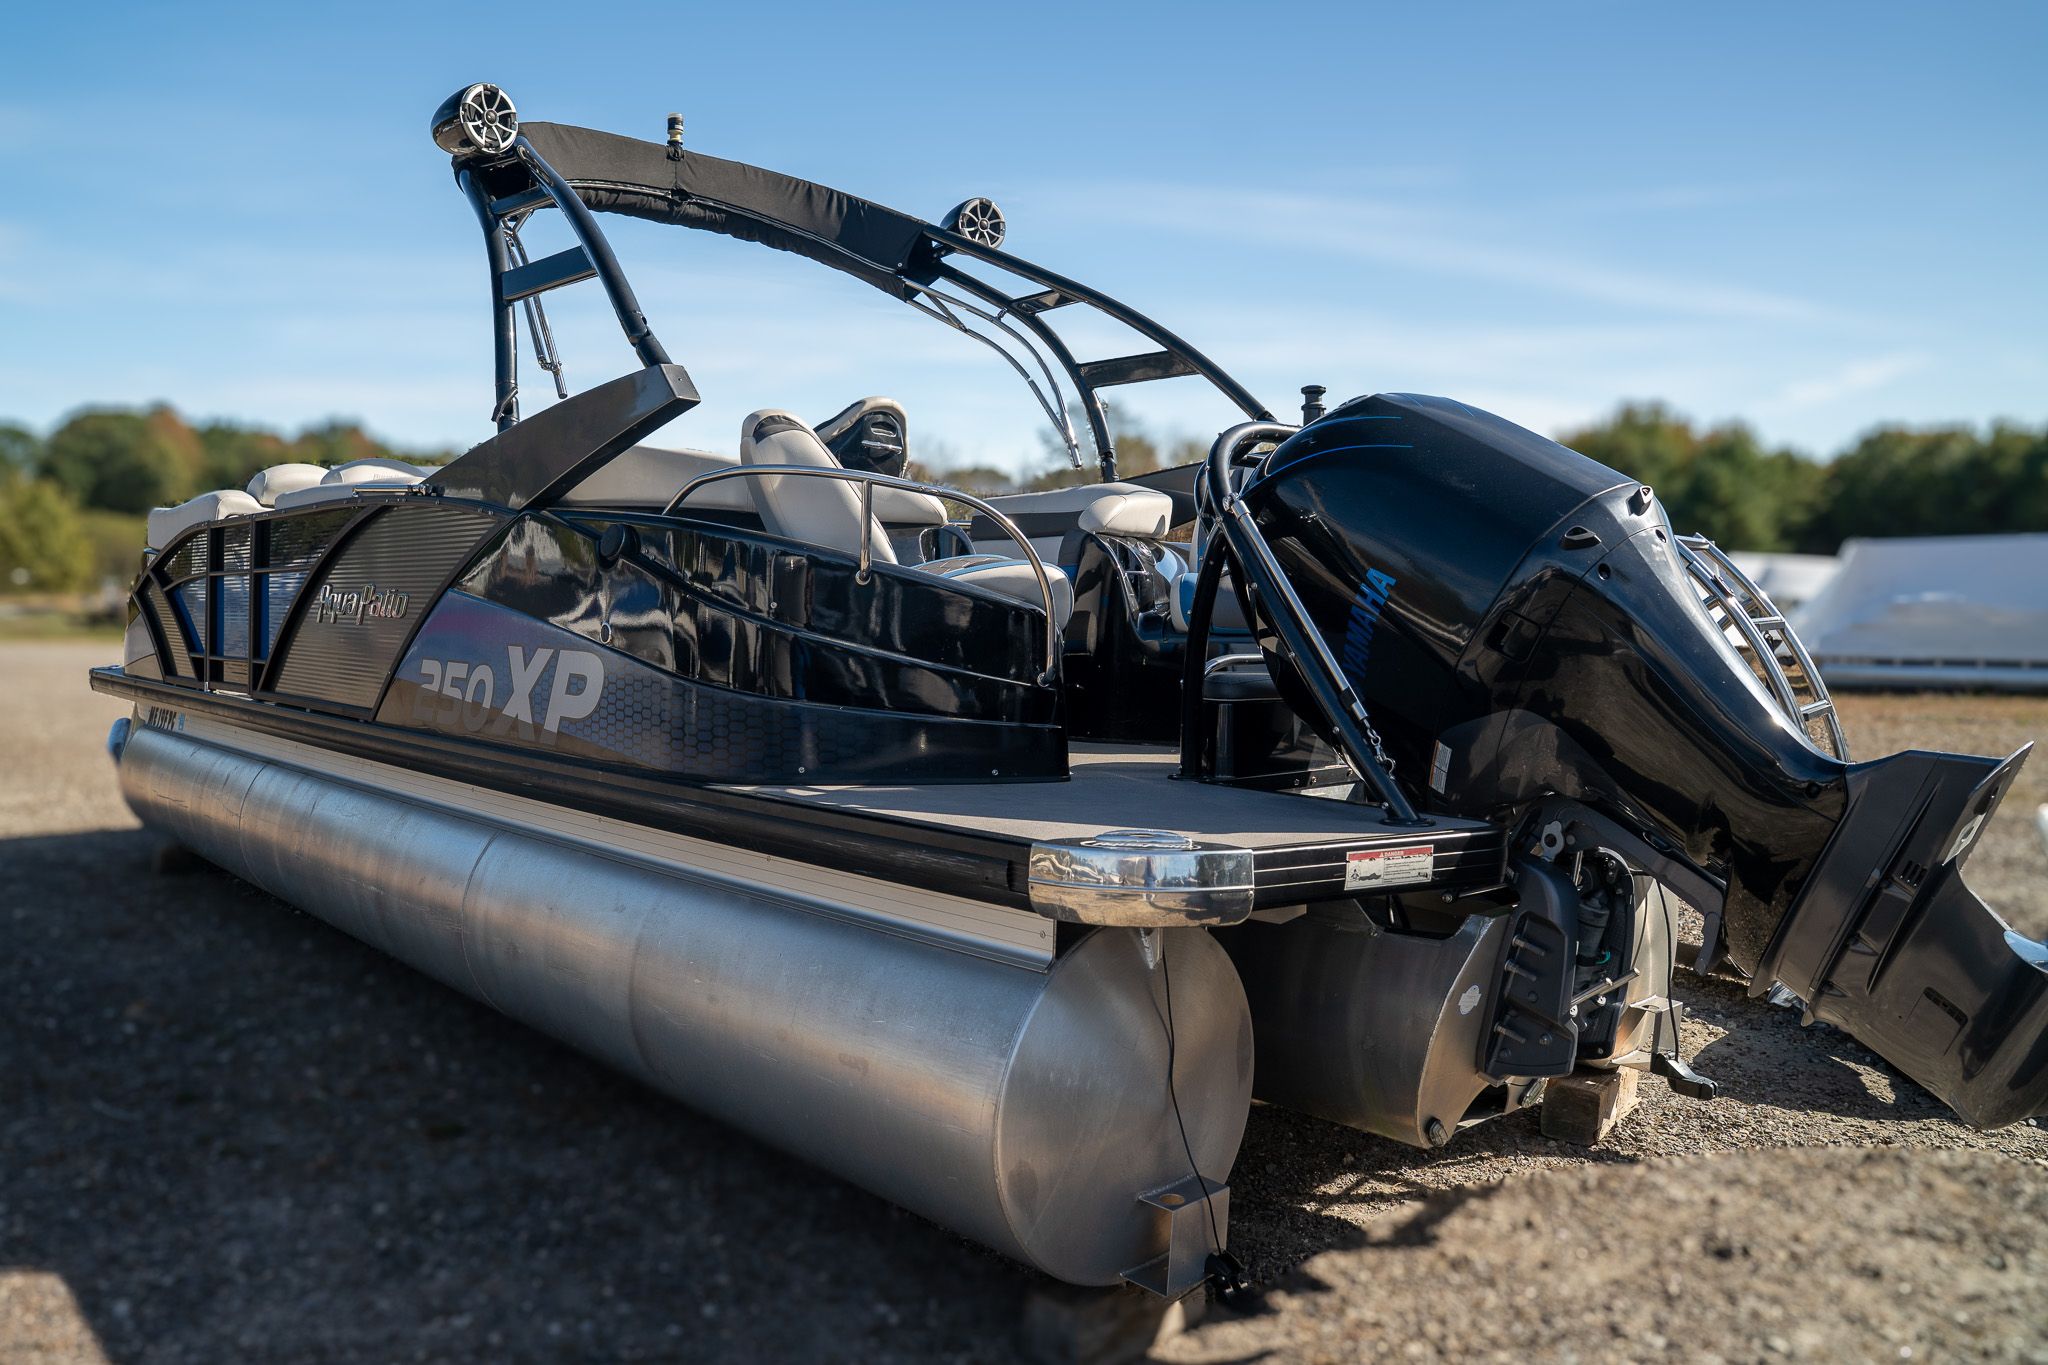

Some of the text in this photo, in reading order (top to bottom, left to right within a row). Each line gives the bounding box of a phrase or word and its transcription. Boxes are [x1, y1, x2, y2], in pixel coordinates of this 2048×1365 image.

[1343, 567, 1396, 678] YAMAHA
[414, 645, 605, 745] 250 XP
